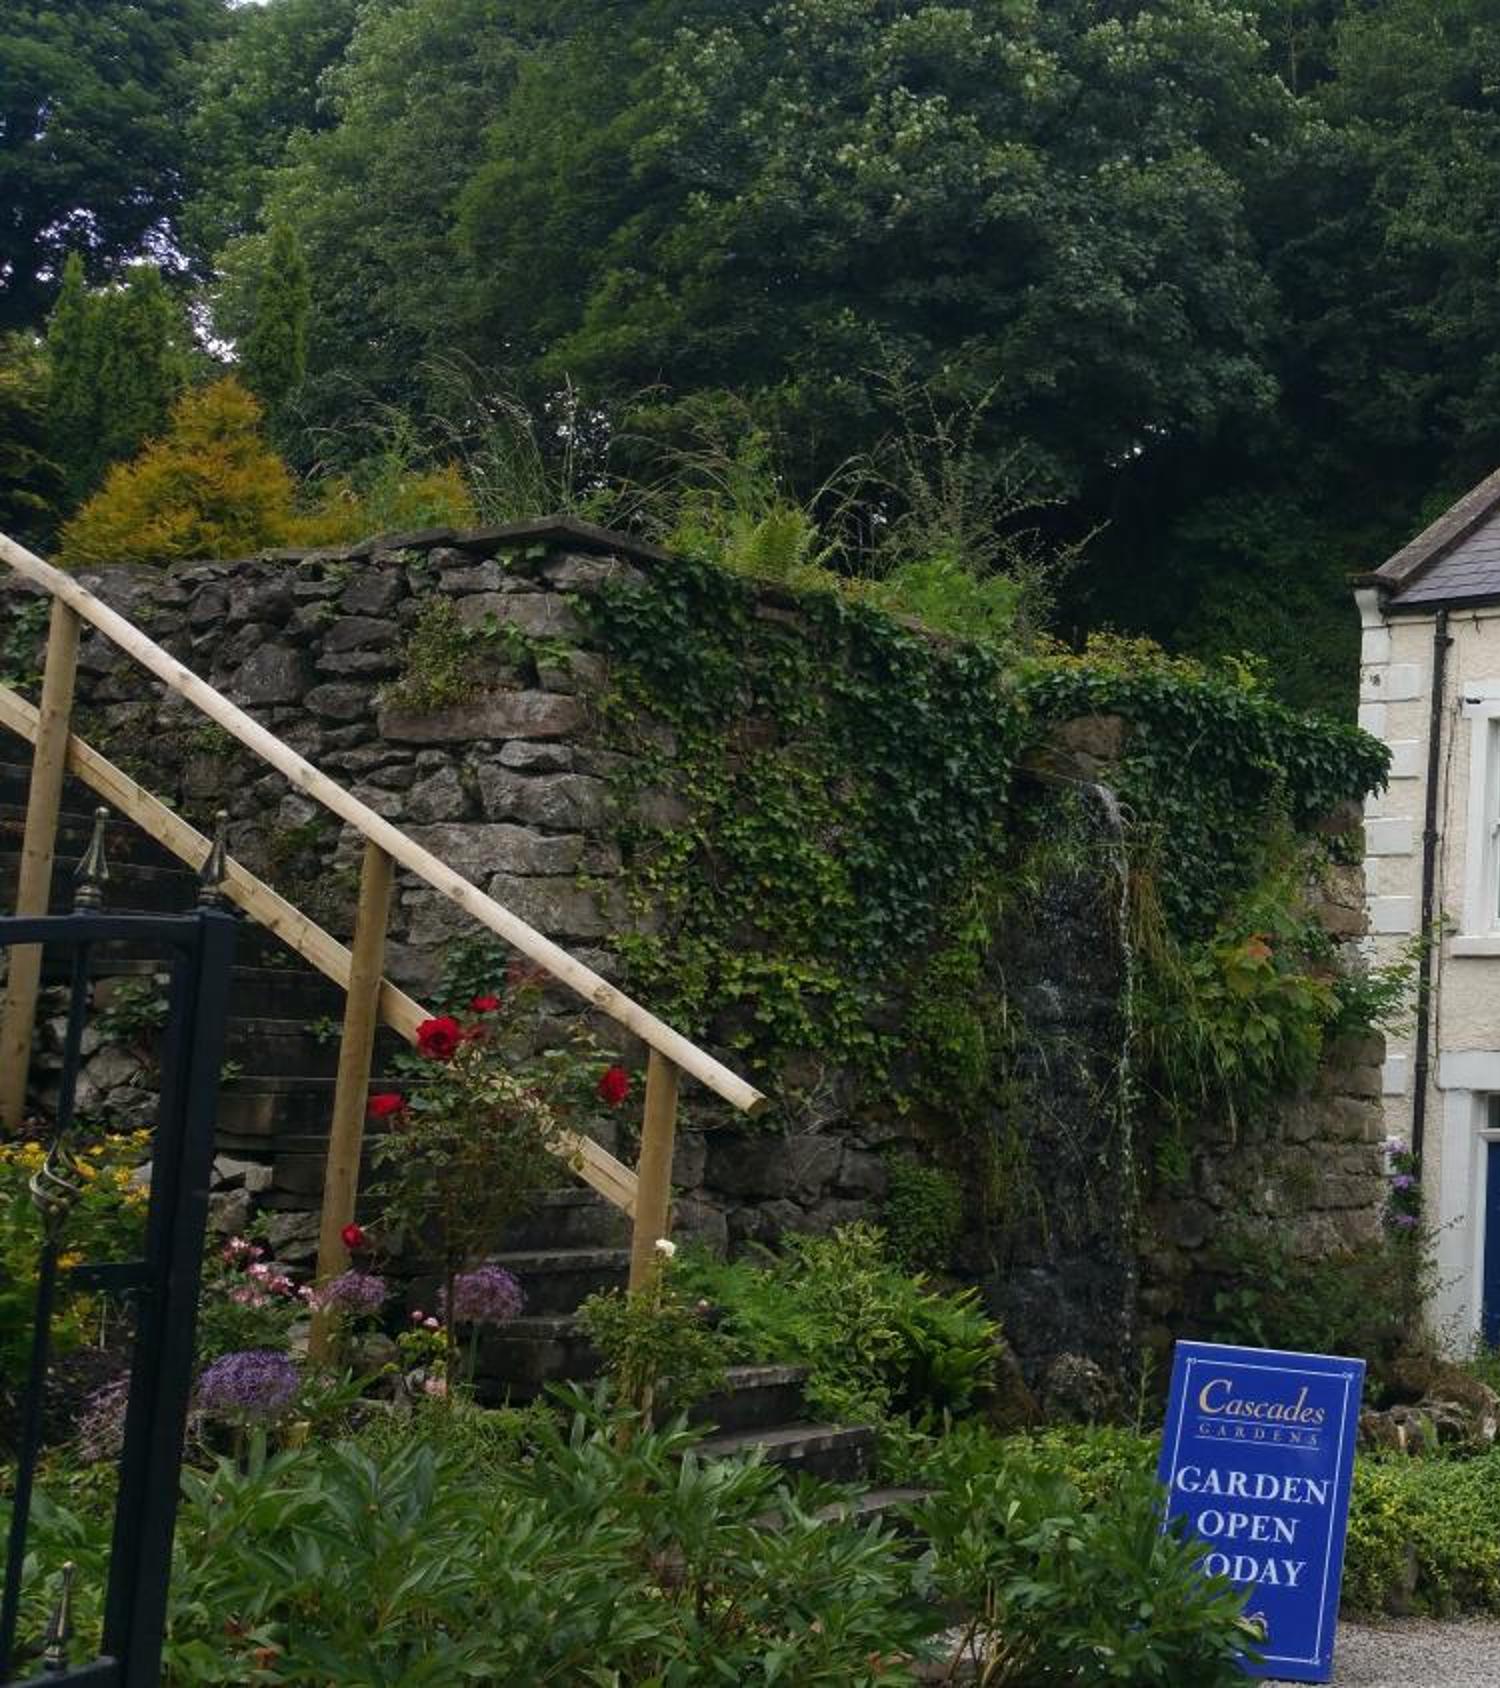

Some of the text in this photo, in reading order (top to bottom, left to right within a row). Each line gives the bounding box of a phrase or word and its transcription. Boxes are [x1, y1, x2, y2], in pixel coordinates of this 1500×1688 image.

[1199, 1379, 1325, 1424] Cascades
[1199, 1423, 1318, 1446] GARDENS
[1176, 1465, 1330, 1505] GARDEN
[1197, 1509, 1299, 1544] OPEN
[1203, 1553, 1306, 1587] ODAY
